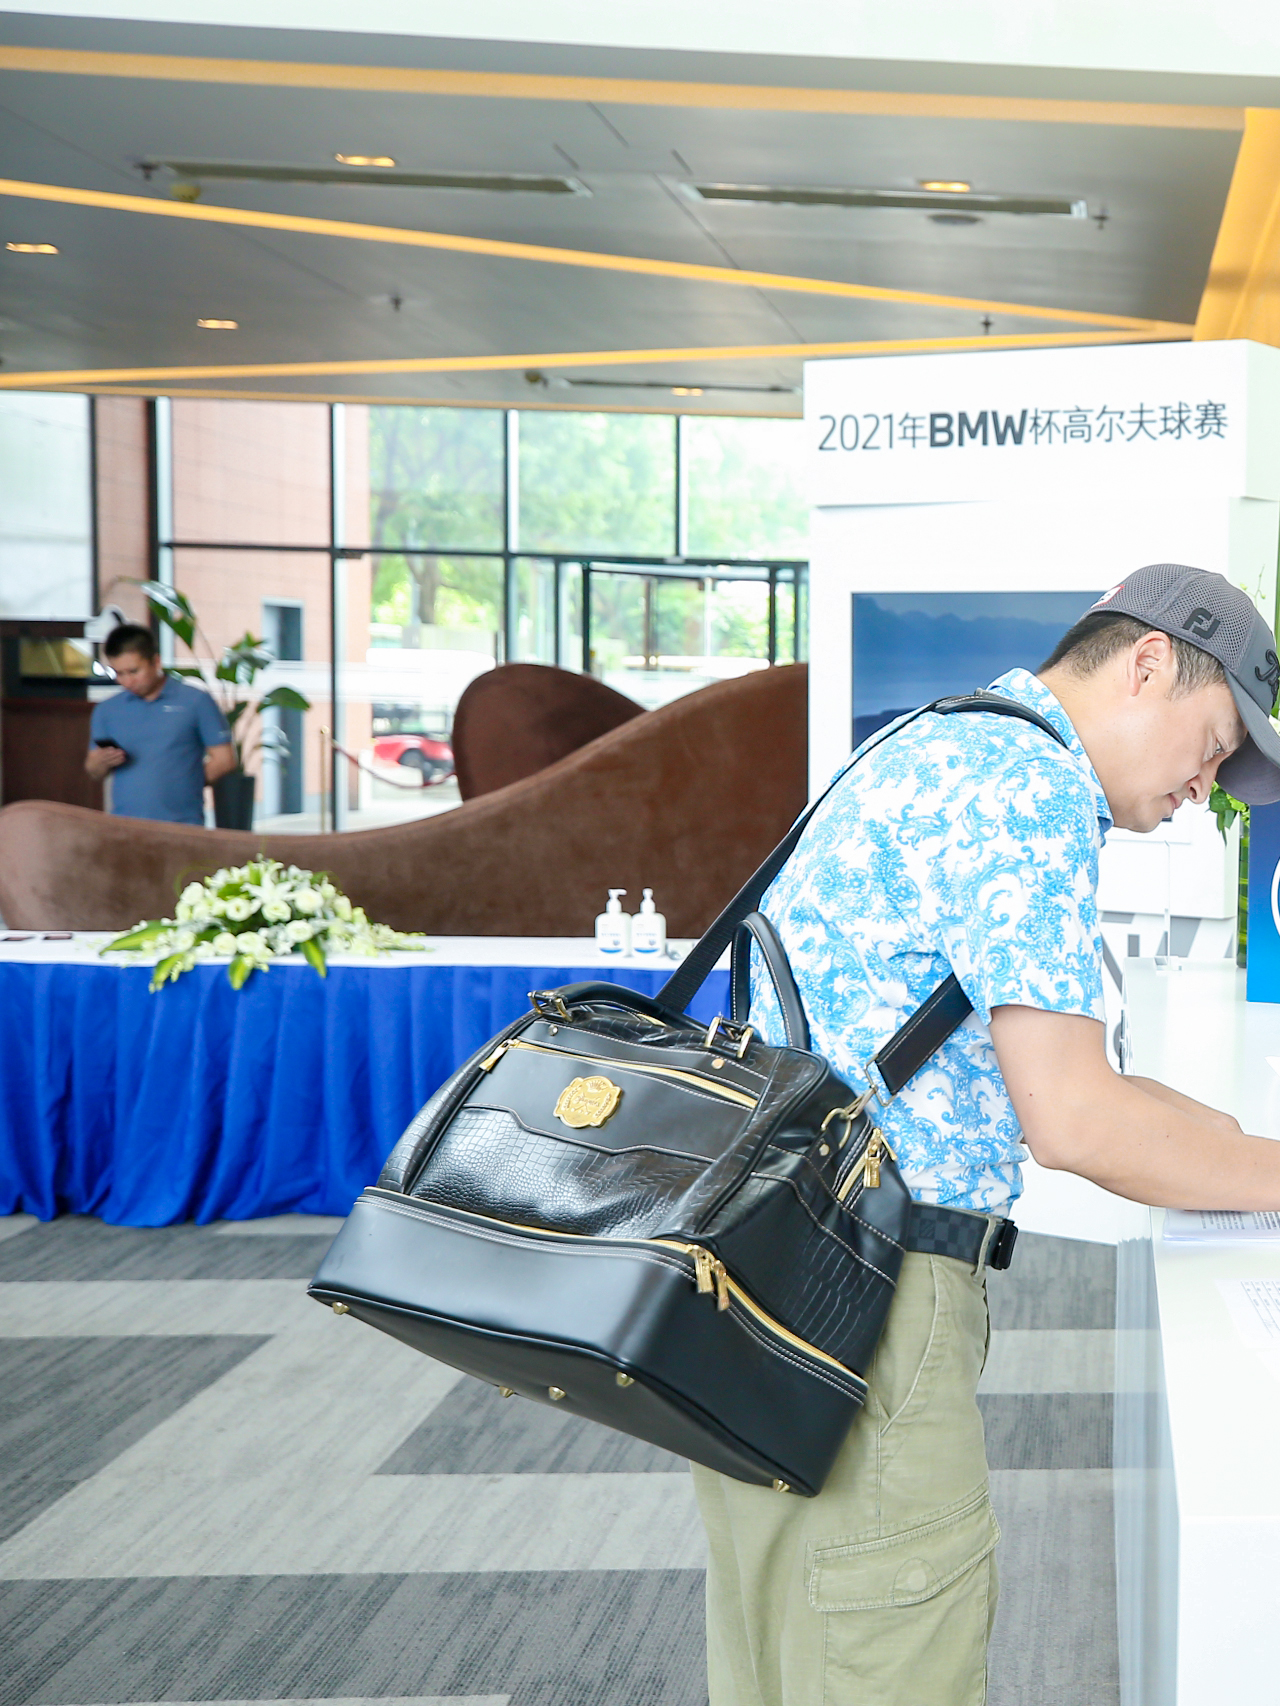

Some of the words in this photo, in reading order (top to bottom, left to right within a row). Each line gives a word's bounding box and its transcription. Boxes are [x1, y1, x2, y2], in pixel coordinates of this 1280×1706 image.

[818, 399, 1229, 451] 2021年BMW杯高尔夫球赛
